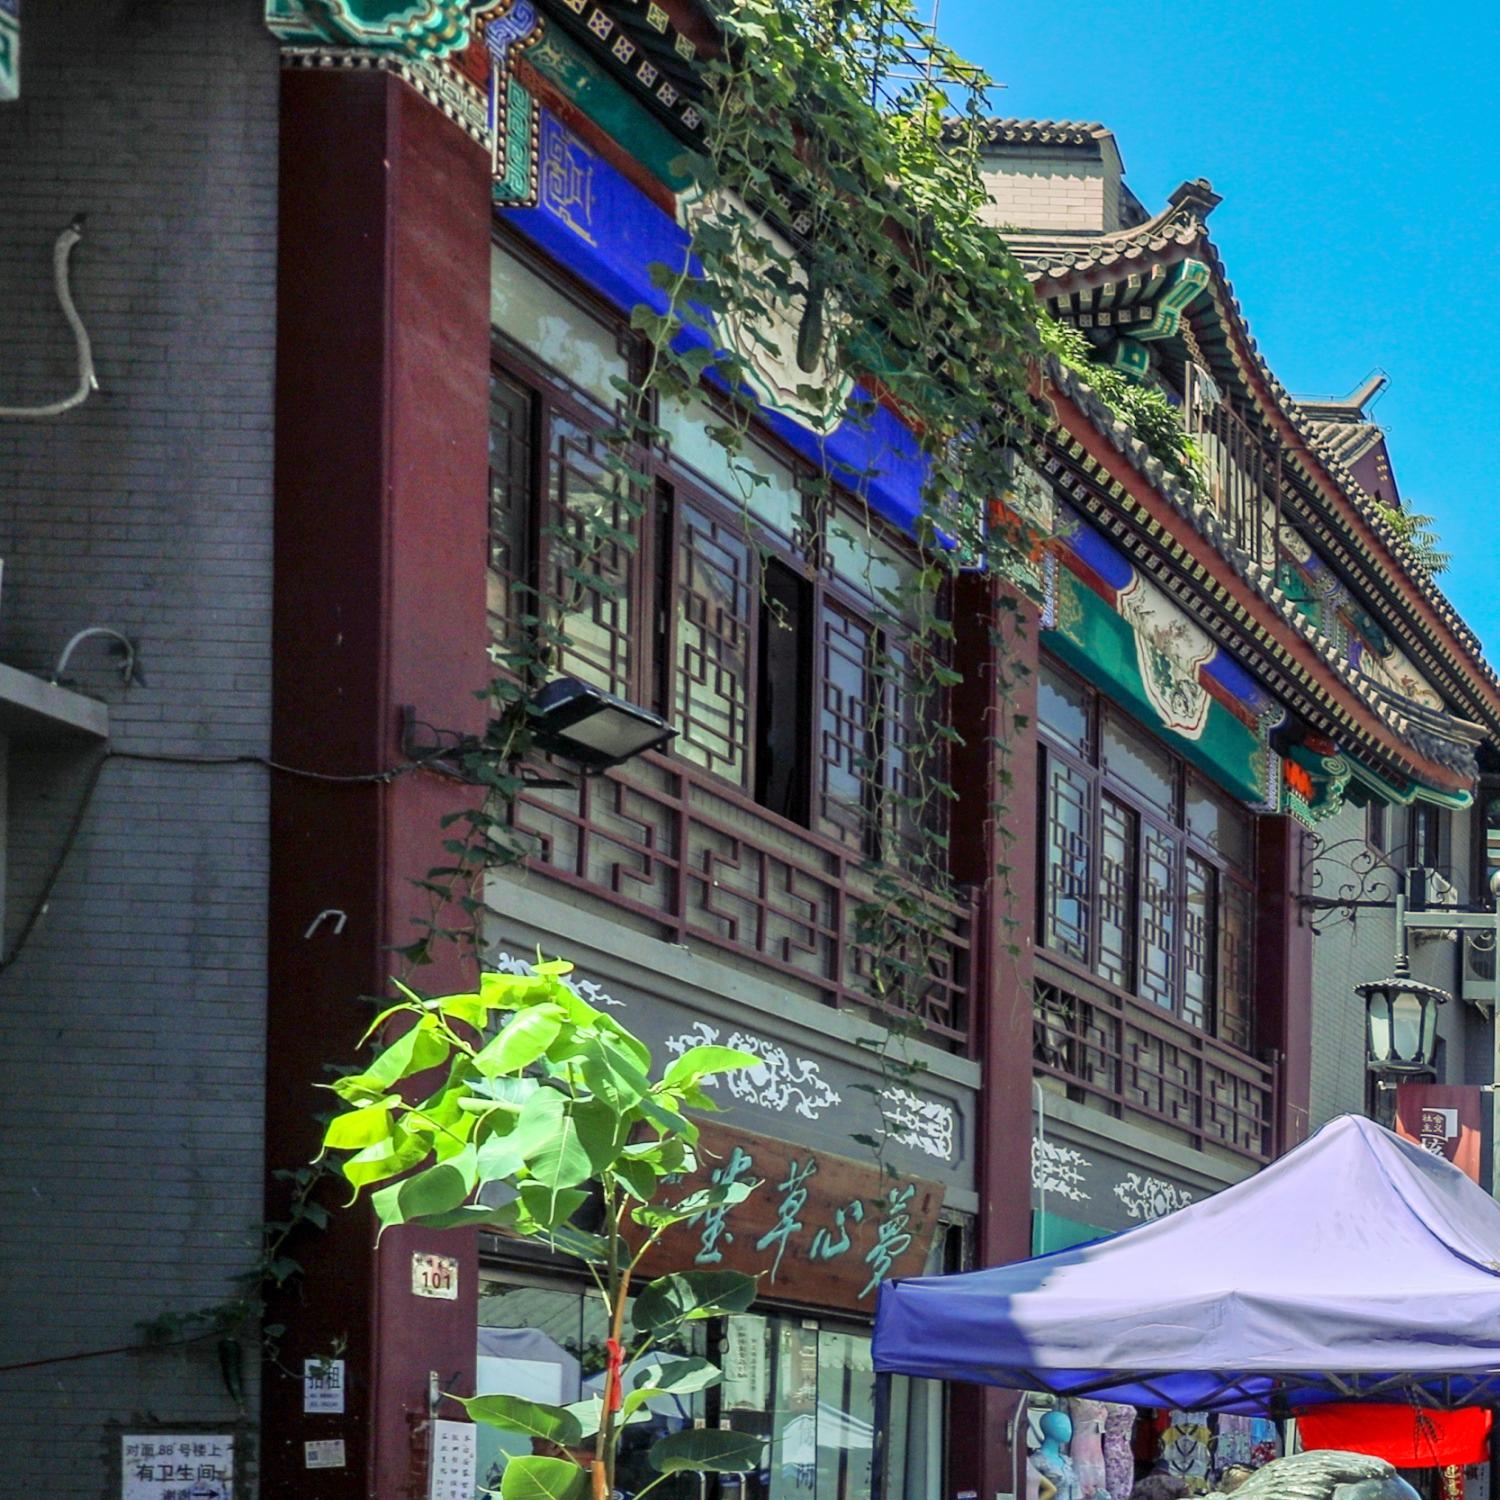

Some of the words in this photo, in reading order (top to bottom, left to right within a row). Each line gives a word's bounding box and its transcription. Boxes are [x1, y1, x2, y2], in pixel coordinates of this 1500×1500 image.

[422, 1271, 451, 1290] 101
[136, 1463, 216, 1482] 有卫生间
